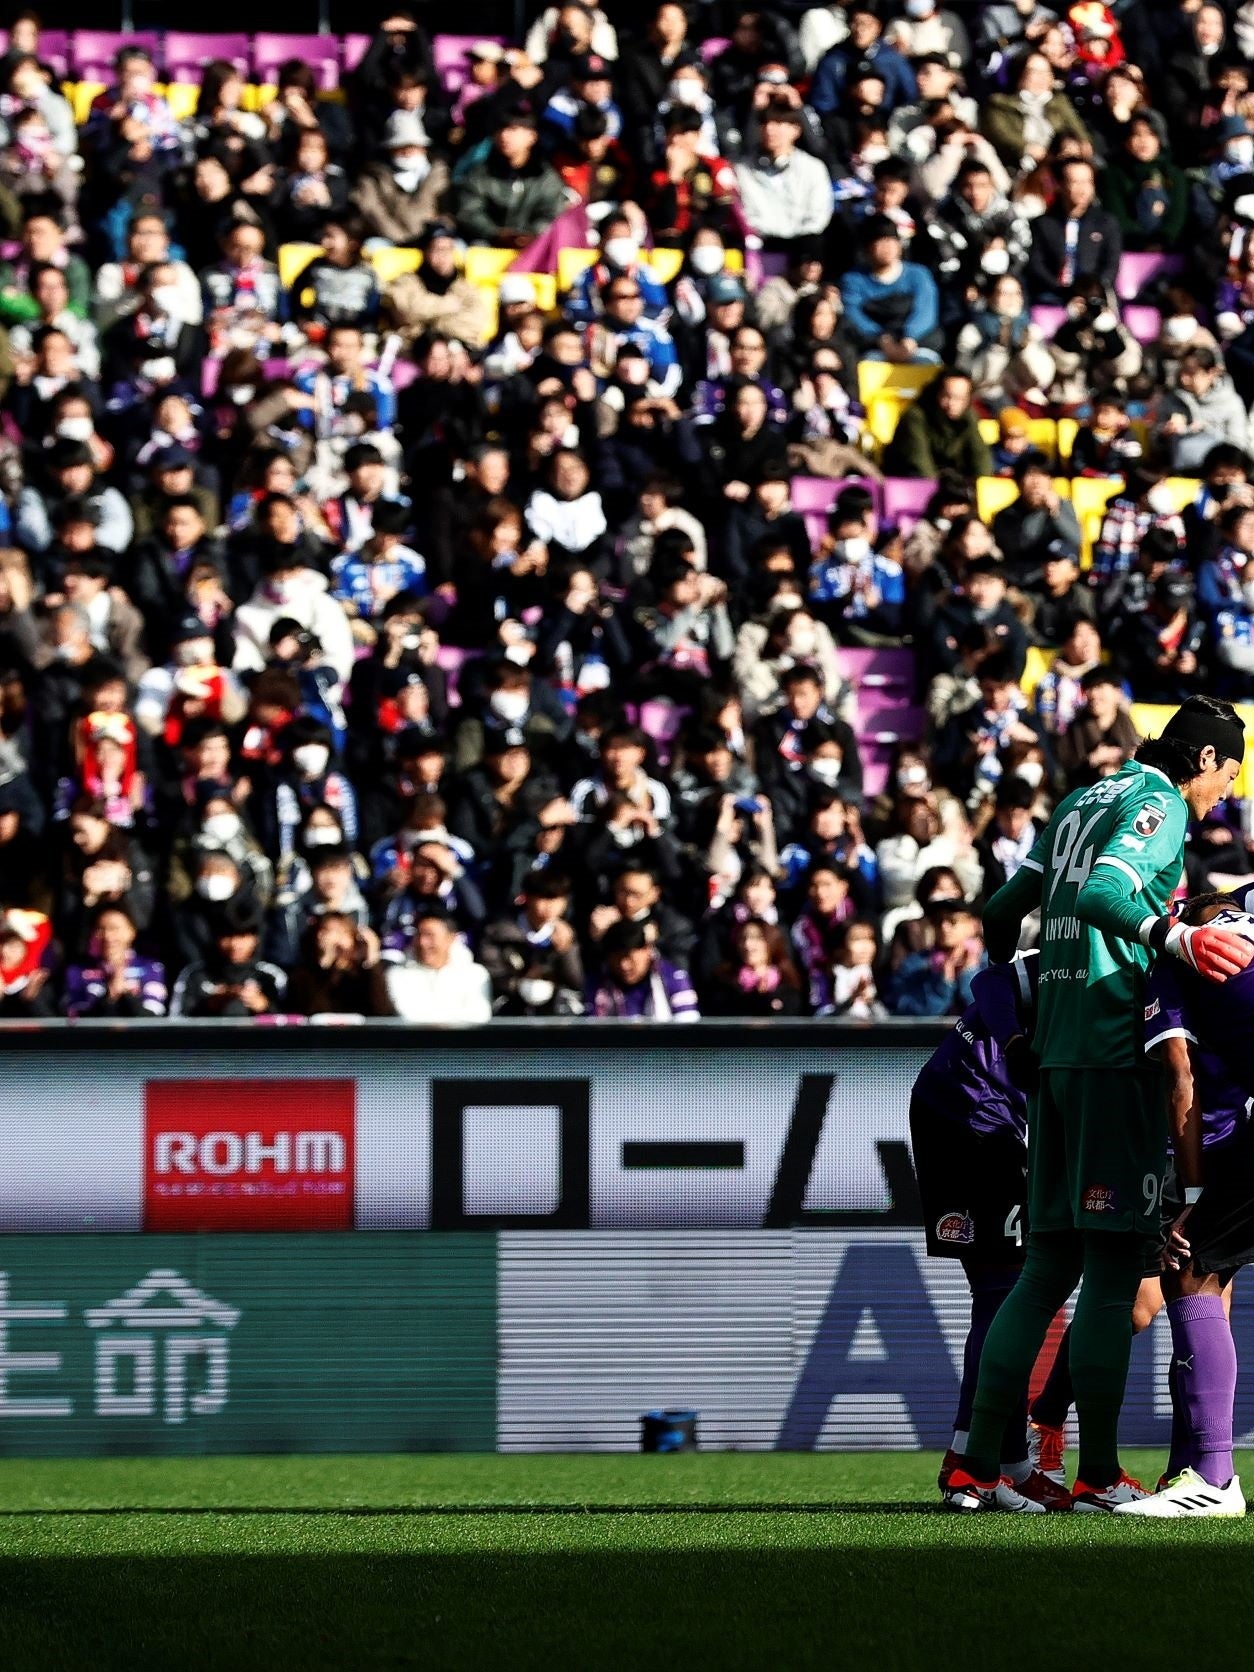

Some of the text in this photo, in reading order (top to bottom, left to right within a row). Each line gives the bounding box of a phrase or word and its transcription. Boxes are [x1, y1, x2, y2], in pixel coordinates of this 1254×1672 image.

[1051, 807, 1109, 912] 94
[153, 1131, 346, 1174] ROHM
[1004, 1204, 1023, 1247] 4
